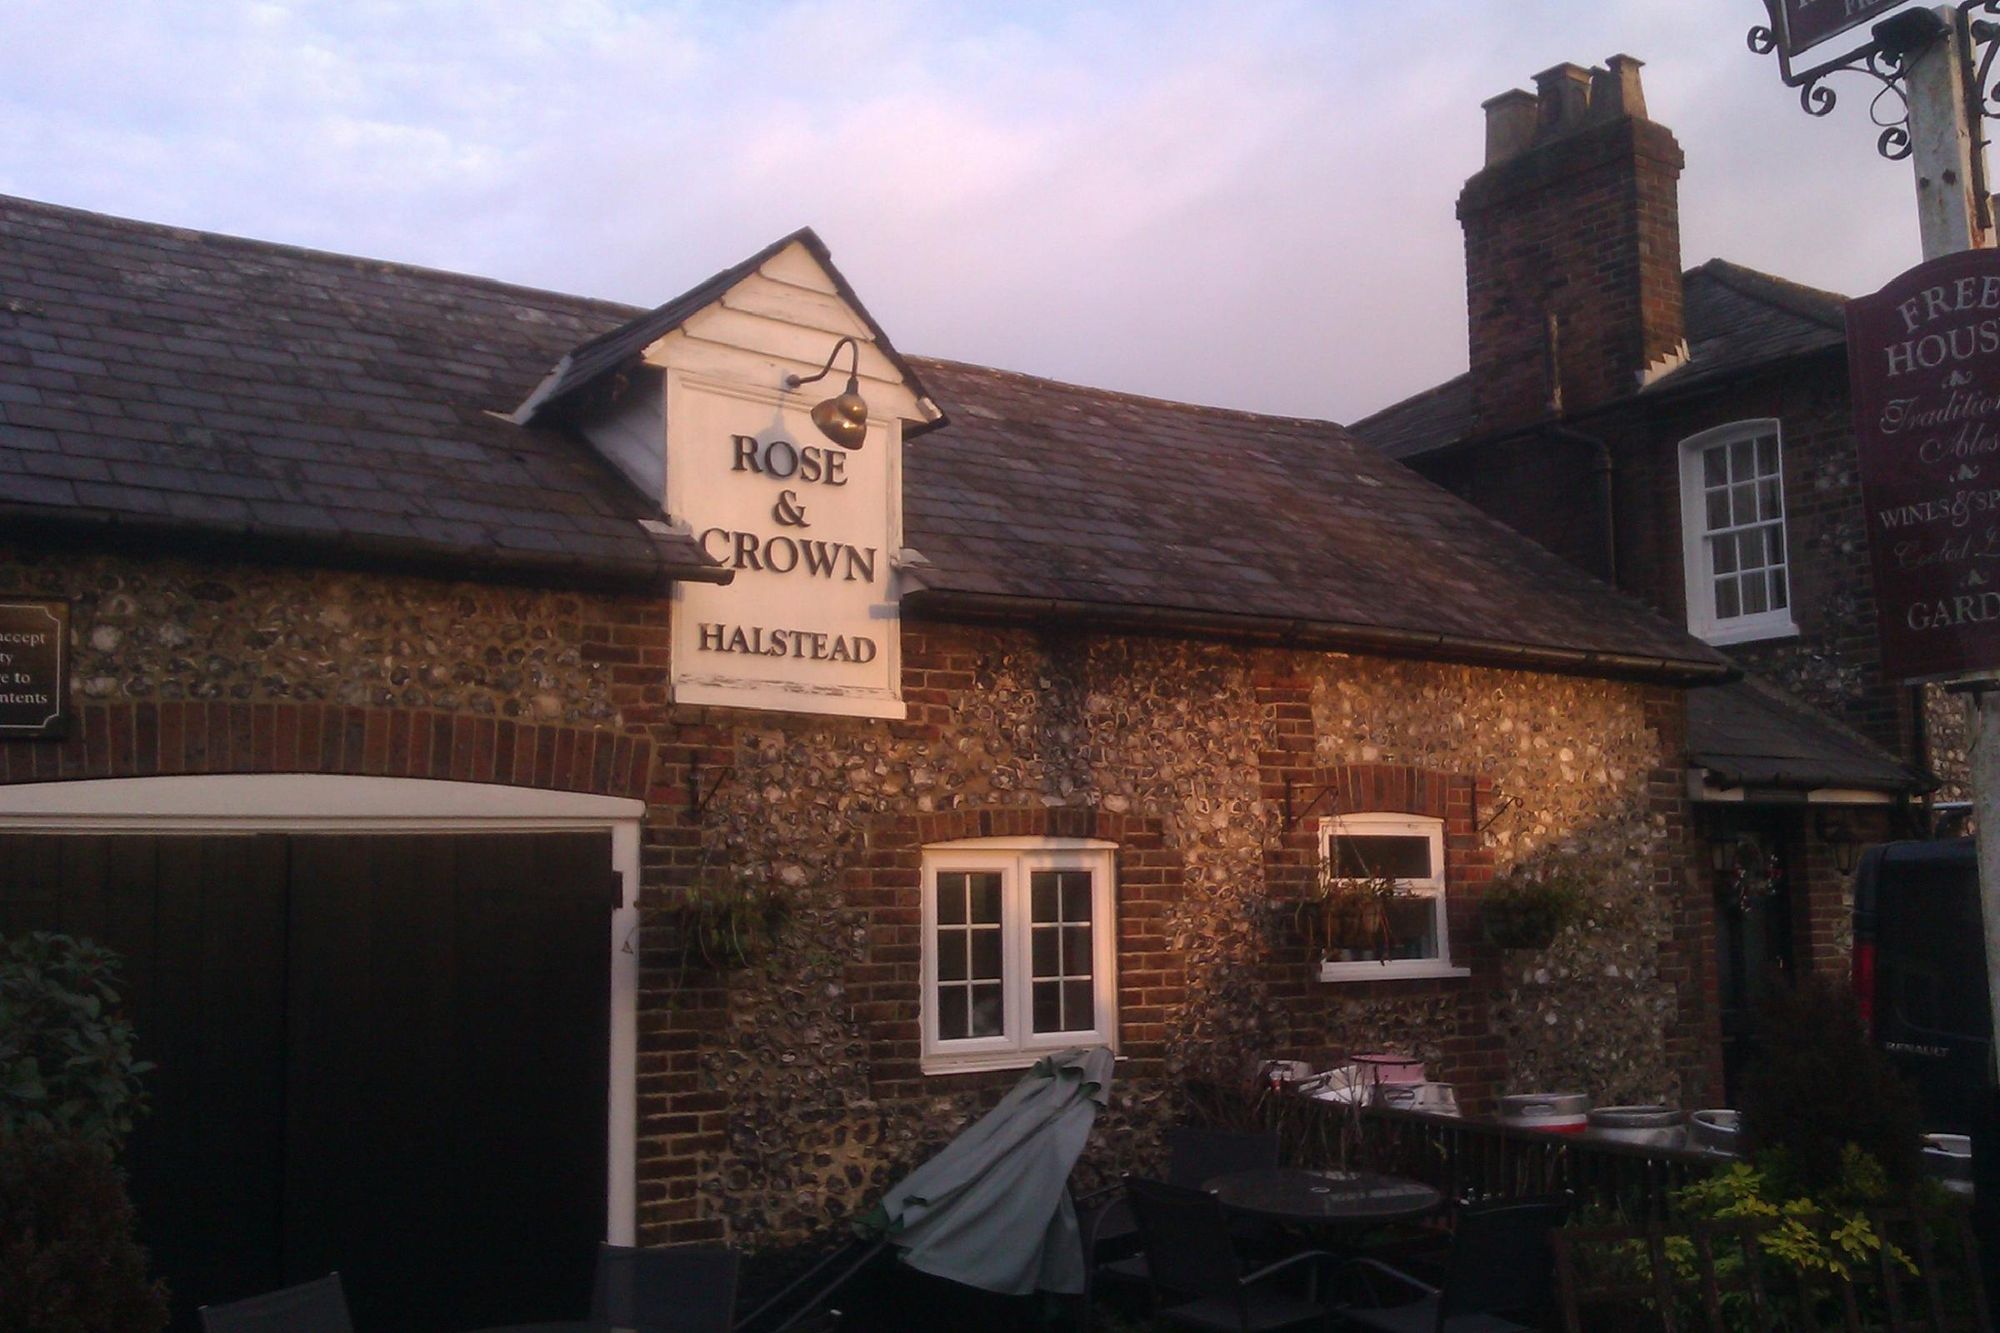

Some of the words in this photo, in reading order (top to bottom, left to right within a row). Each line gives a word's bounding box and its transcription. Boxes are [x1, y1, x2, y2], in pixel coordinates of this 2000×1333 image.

[1896, 276, 2000, 334] FREE
[1884, 317, 2000, 377] HOUS
[731, 434, 848, 487] ROSE
[773, 490, 811, 528] &
[701, 527, 877, 583] CROWN
[1907, 592, 2000, 630] GARD
[698, 622, 877, 664] HALSTEAD
[15, 672, 31, 685] to
